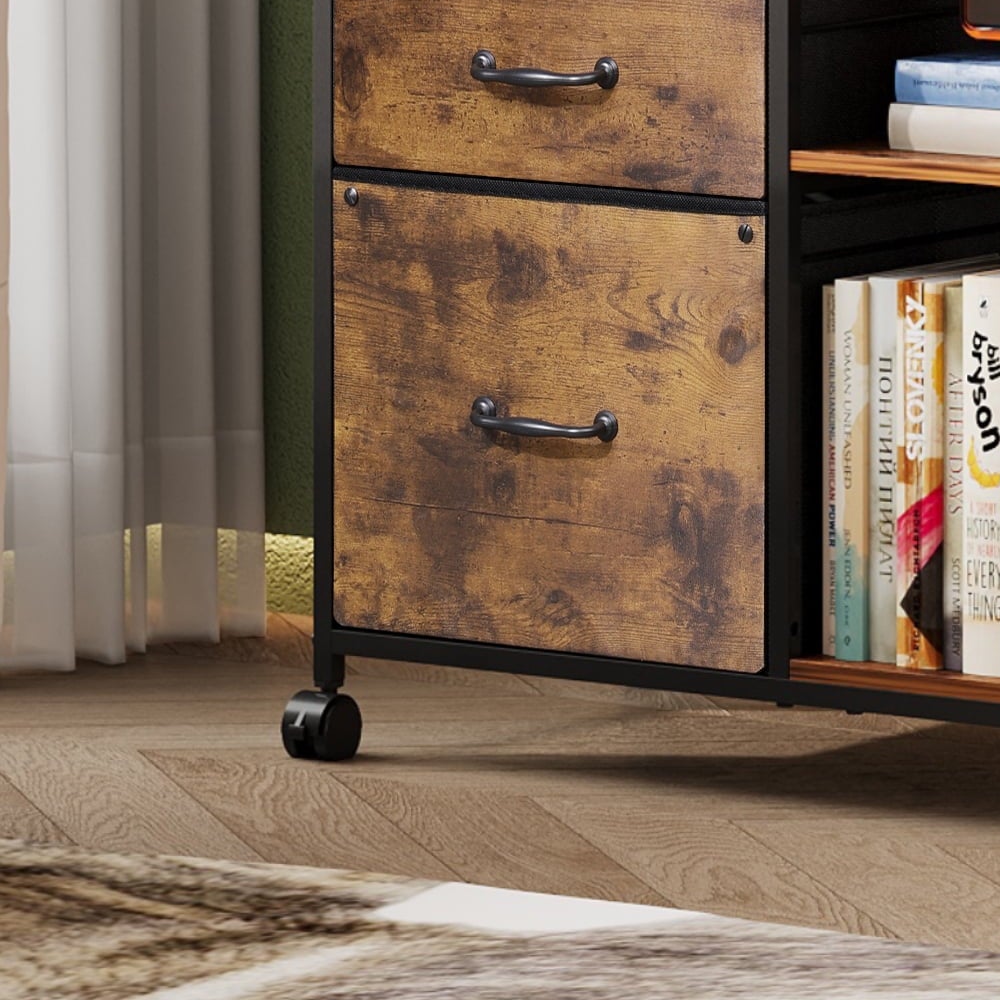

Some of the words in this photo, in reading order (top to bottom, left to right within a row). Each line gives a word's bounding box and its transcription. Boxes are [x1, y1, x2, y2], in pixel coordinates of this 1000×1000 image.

[843, 329, 853, 394] WOMAN
[906, 294, 927, 461] SLOVENKY
[967, 330, 1000, 453] bryson
[879, 356, 897, 475] ПОНТИЙ
[948, 373, 963, 446] AFTER
[950, 456, 963, 516] DAYS
[828, 503, 836, 548] POWER
[951, 557, 961, 595] SCOTT
